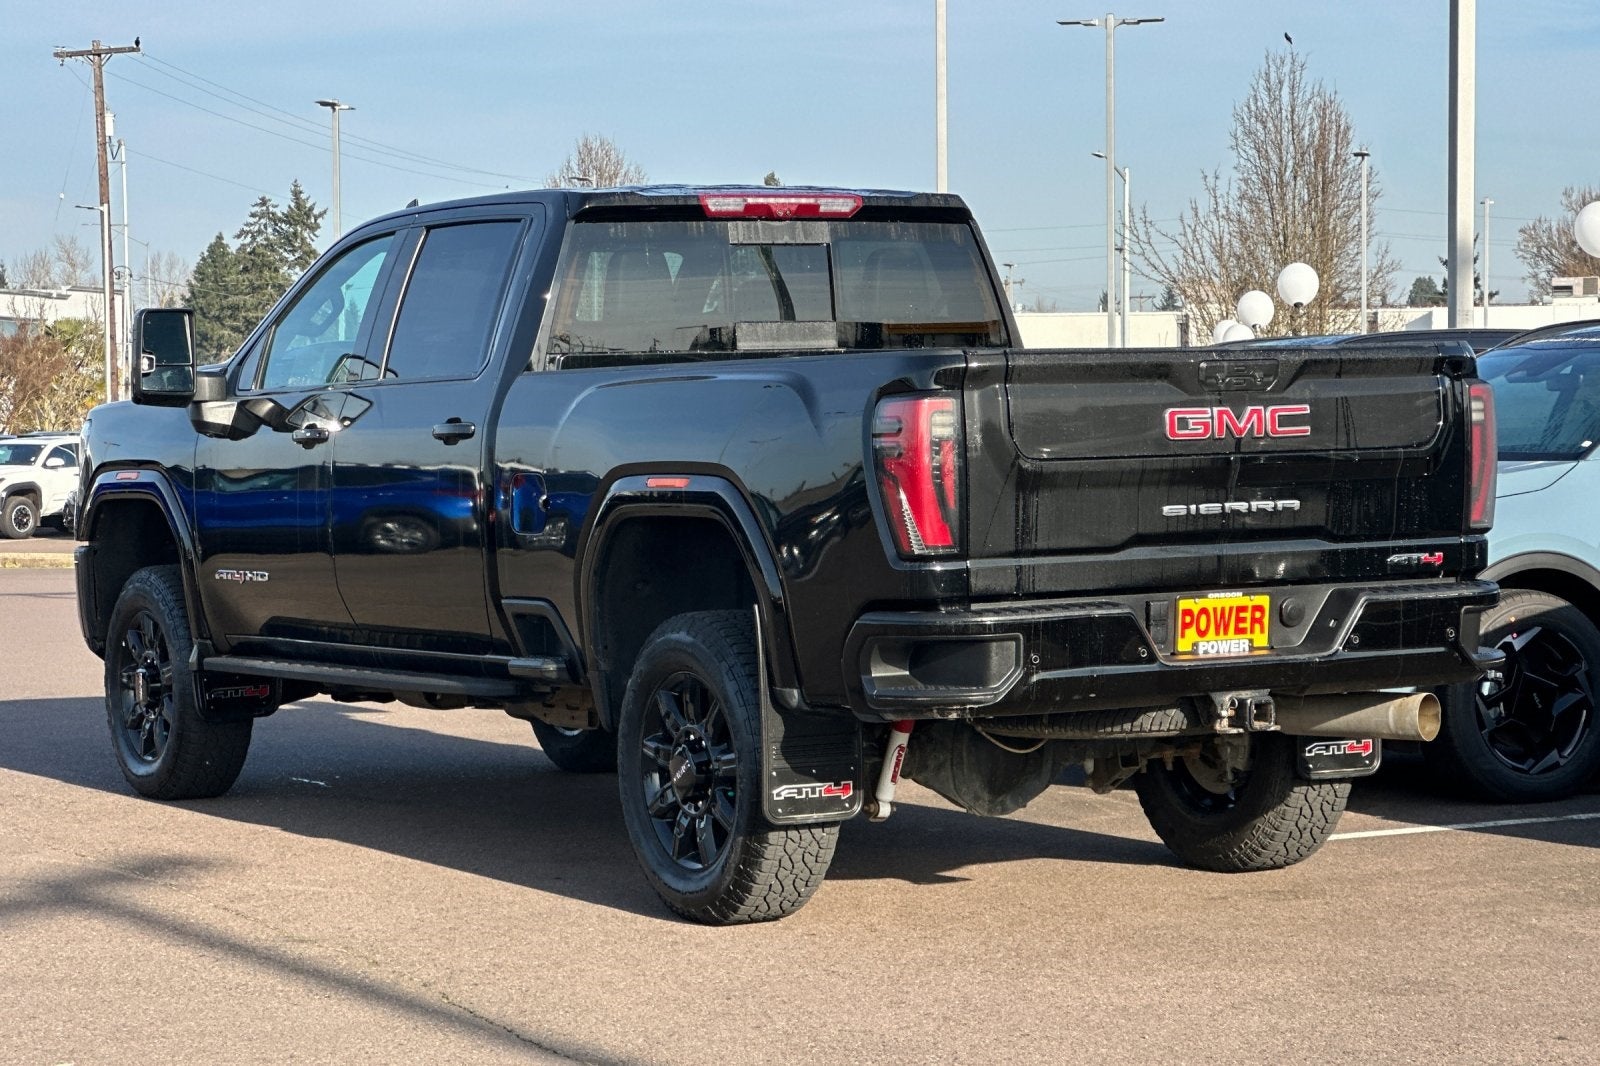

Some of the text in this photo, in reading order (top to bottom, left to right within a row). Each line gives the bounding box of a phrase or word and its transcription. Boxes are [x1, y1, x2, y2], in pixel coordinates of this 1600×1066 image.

[1165, 404, 1311, 440] GMC
[1162, 500, 1300, 517] SIERRA
[1386, 552, 1443, 566] AT4
[1181, 605, 1265, 639] POWER
[1198, 639, 1249, 654] POWER
[1305, 739, 1372, 757] AT4
[772, 781, 853, 800] AT4
